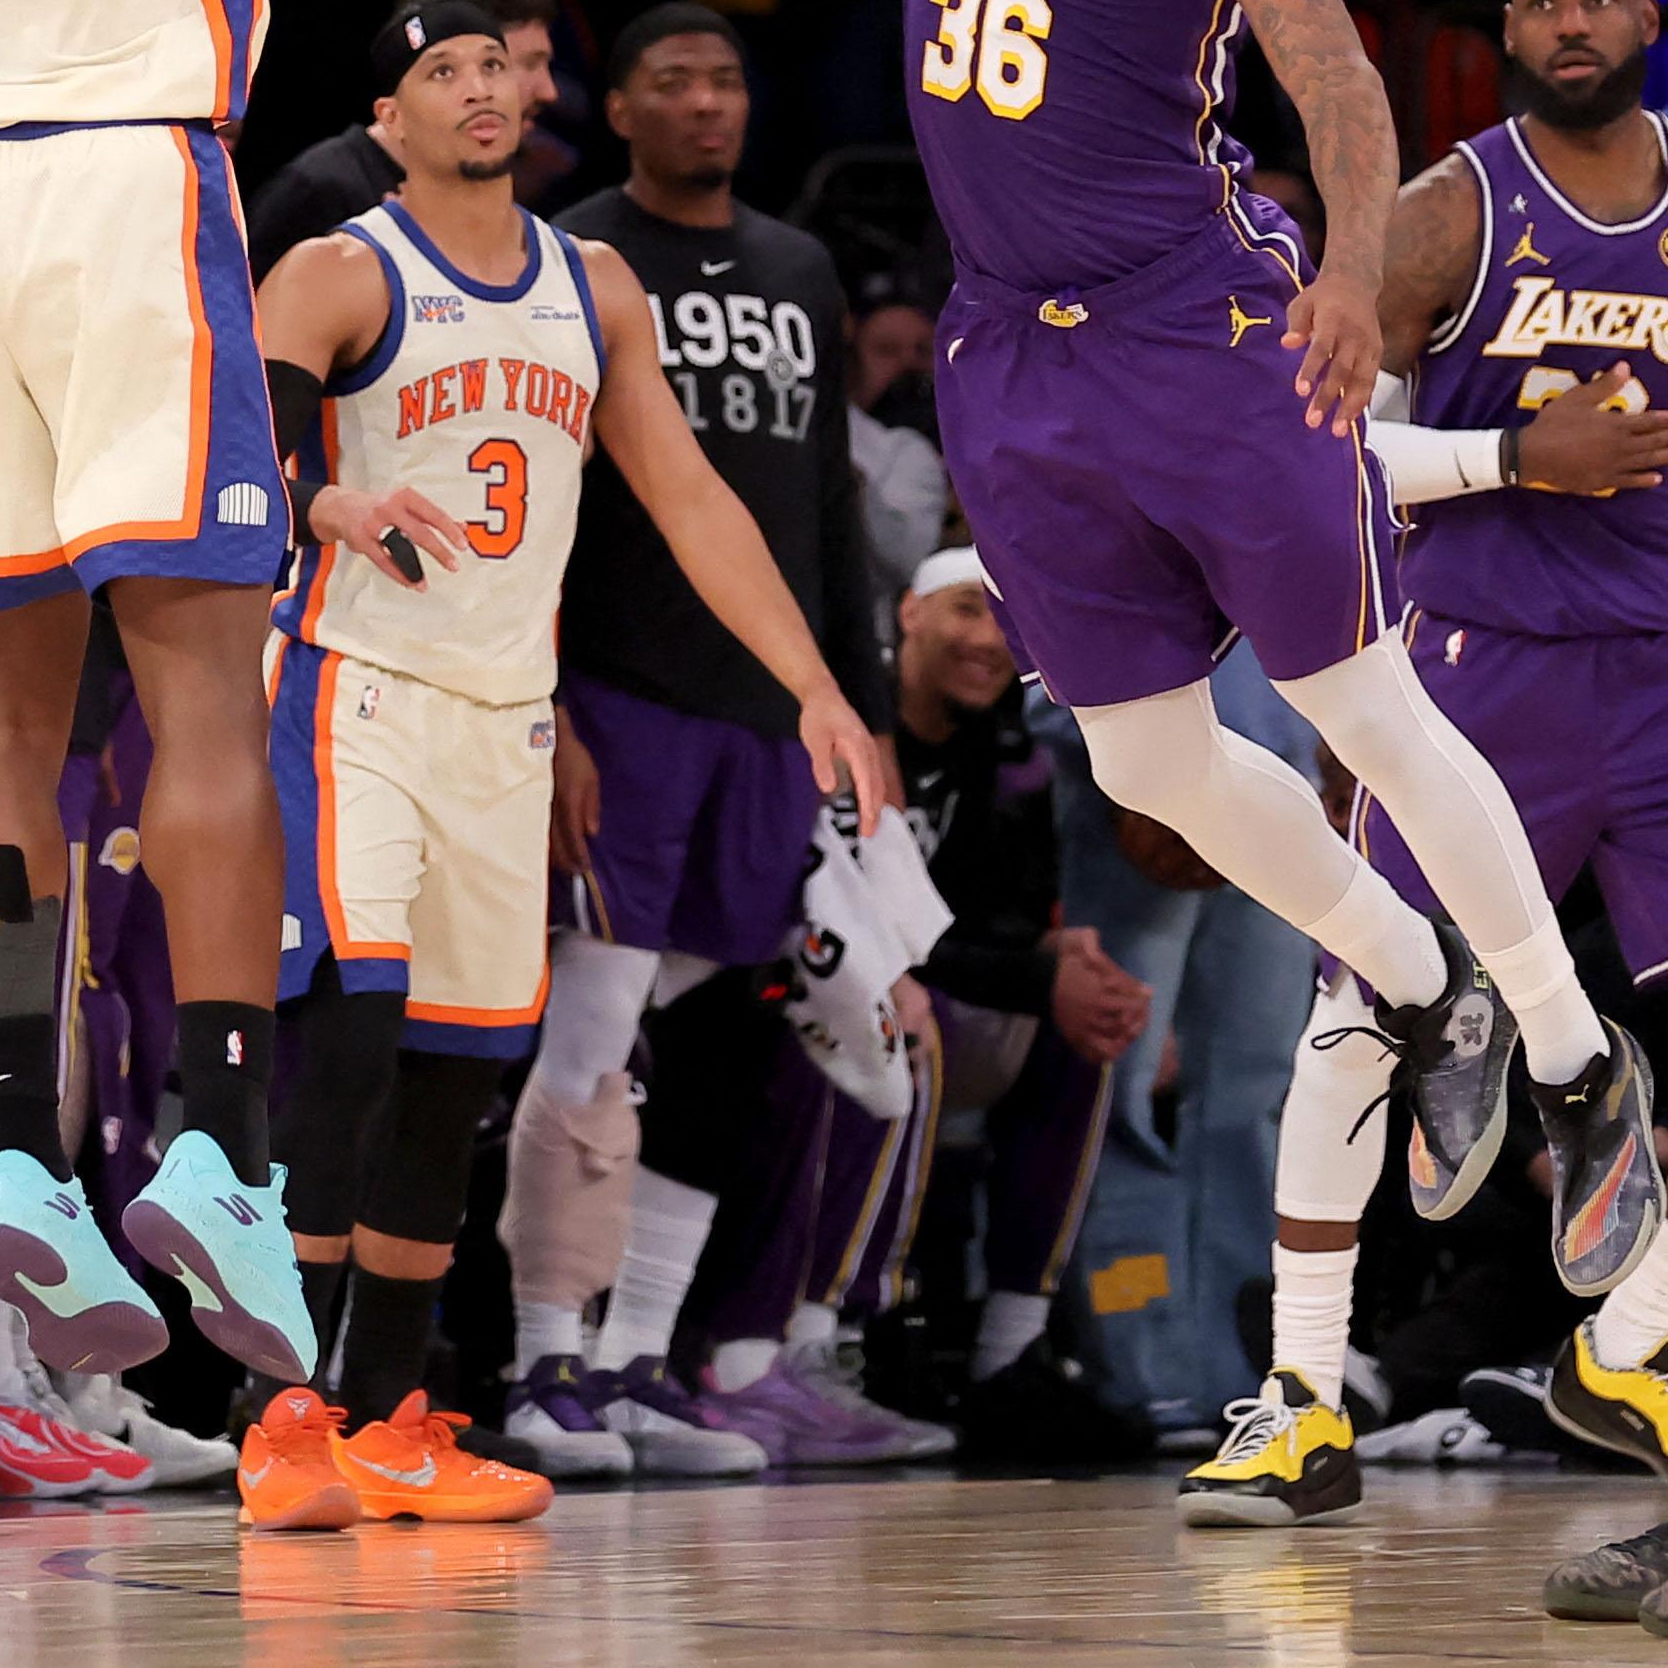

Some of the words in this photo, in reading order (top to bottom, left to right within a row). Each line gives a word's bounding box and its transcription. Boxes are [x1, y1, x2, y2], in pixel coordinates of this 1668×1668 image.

[647, 290, 817, 379] 1950
[396, 358, 488, 440] NEW
[721, 373, 759, 433] 8
[464, 437, 528, 560] 3
